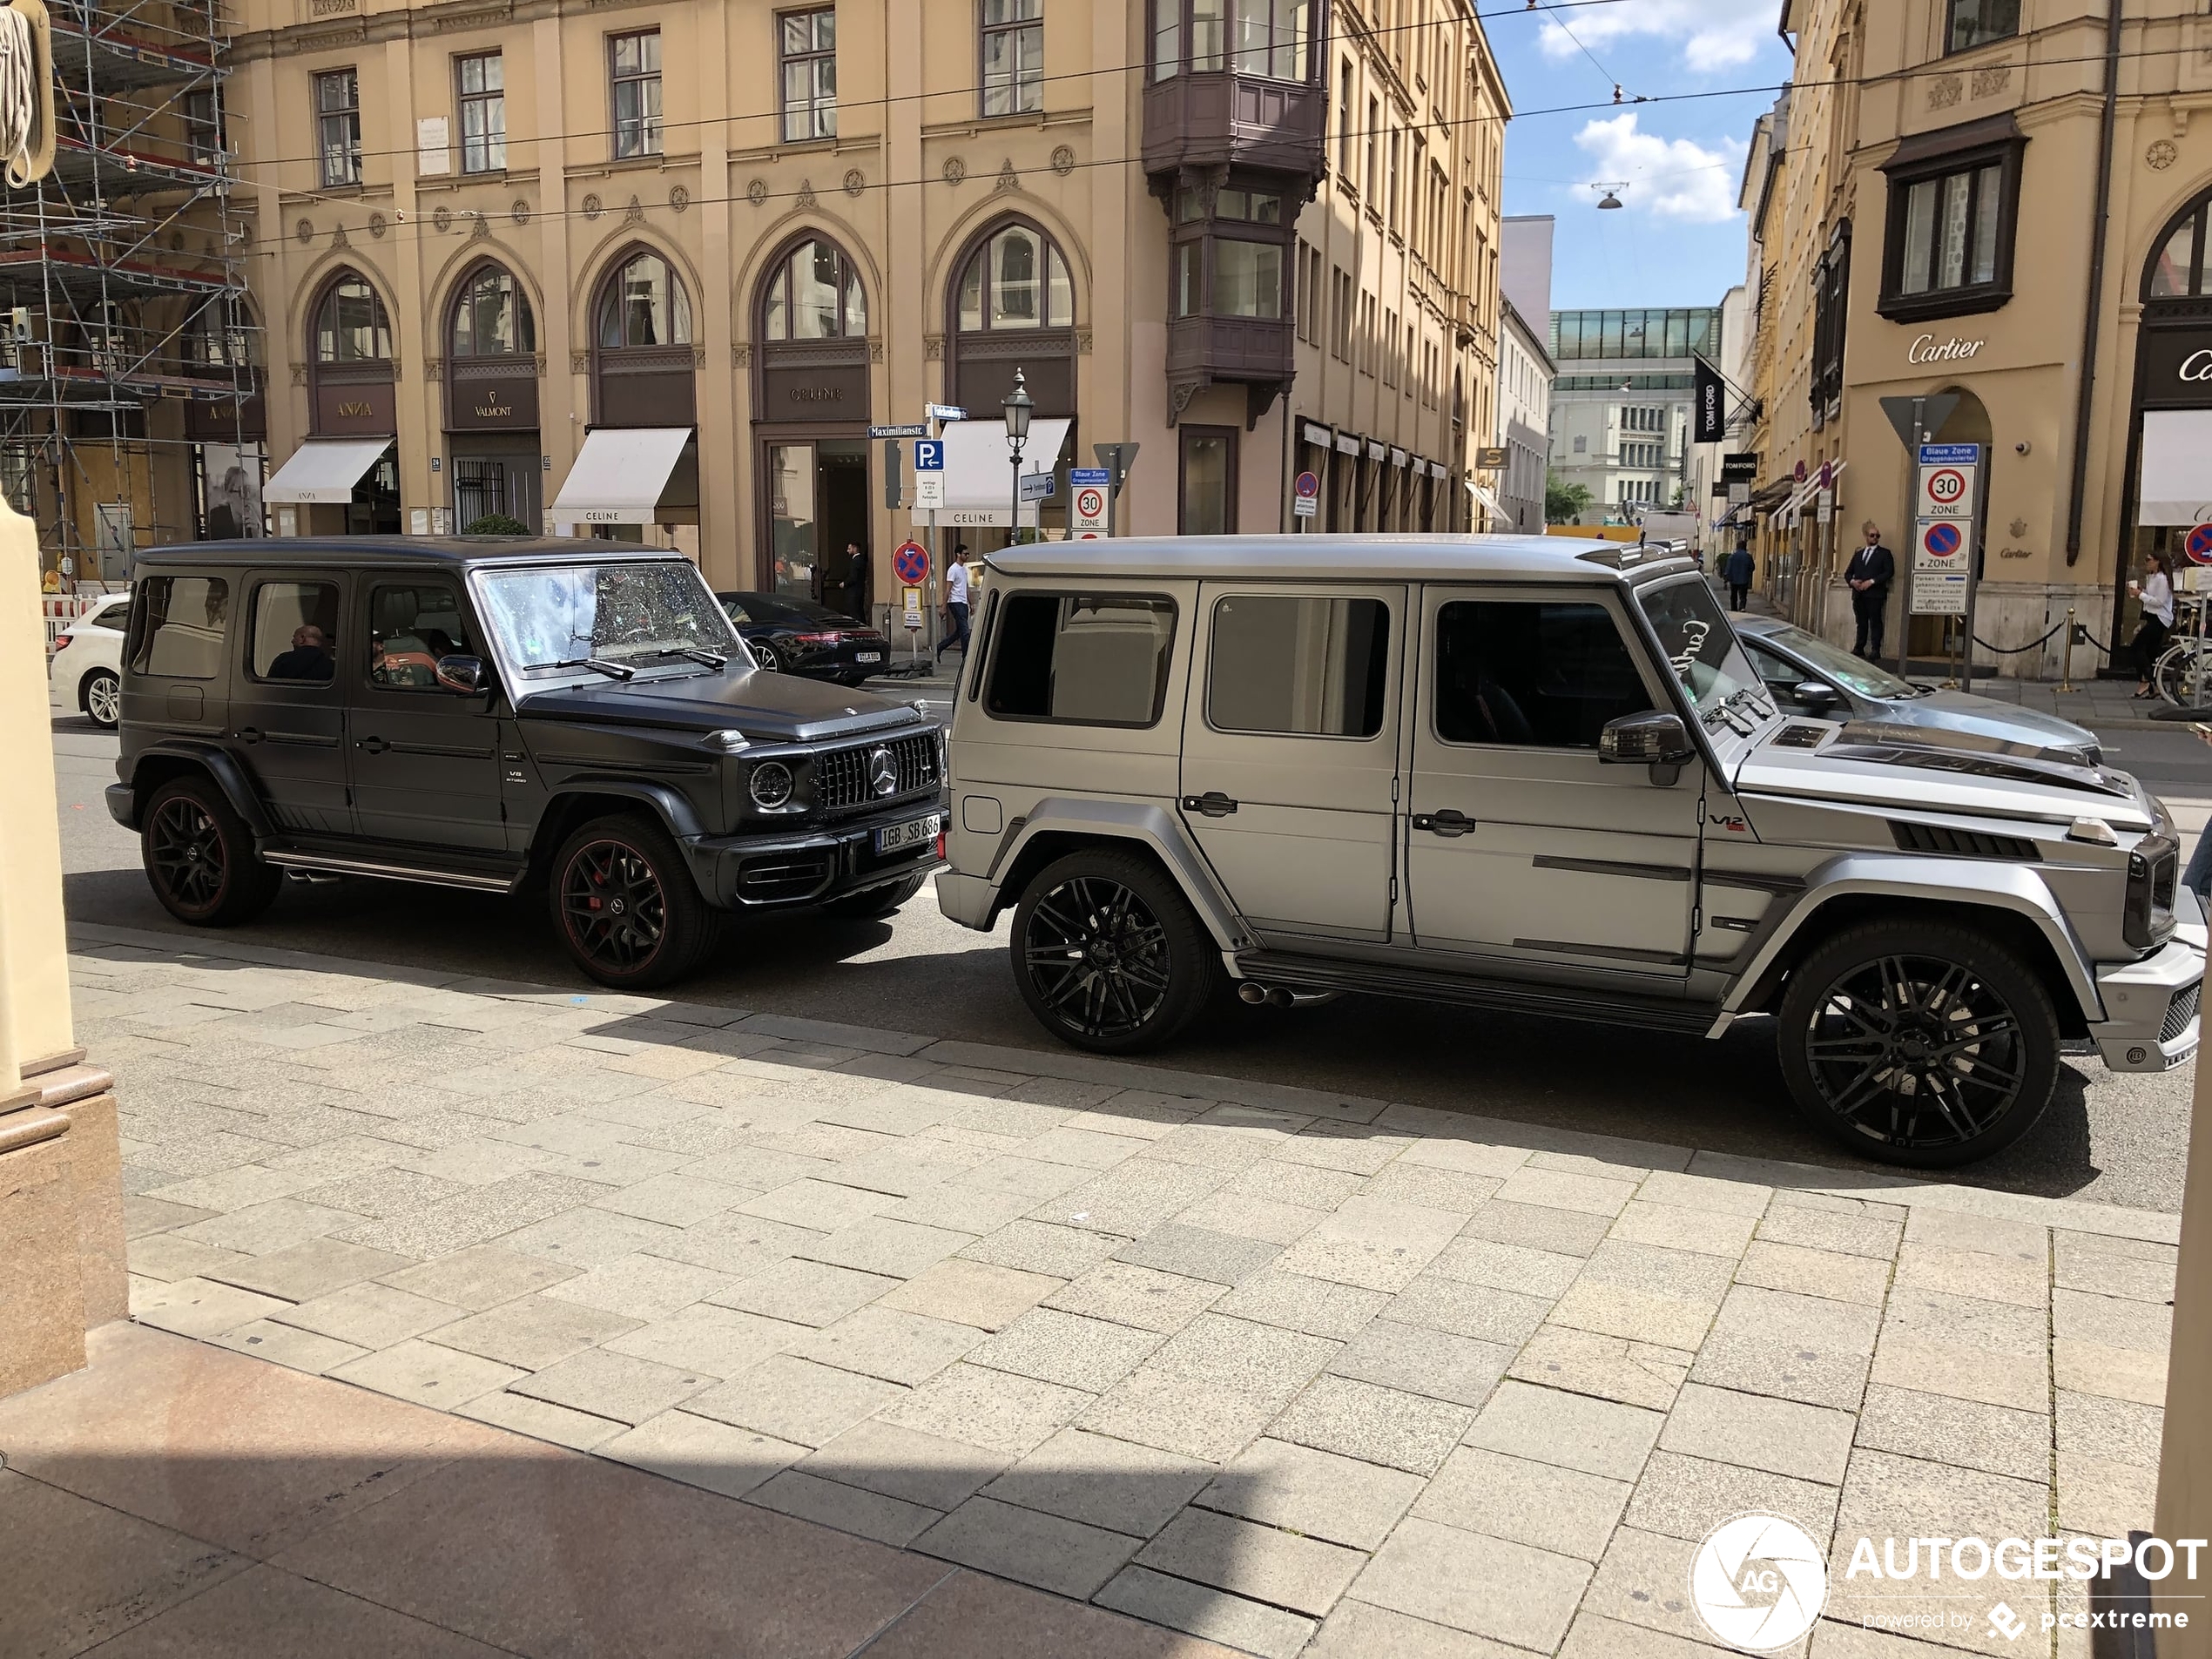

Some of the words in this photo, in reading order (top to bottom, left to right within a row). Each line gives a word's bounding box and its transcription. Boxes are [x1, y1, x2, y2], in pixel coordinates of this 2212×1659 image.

[1908, 334, 1985, 364] Cartier
[791, 388, 843, 401] CELINE
[1706, 384, 1715, 408] FORD
[475, 406, 512, 417] VALMONT
[1706, 408, 1715, 432] TOM
[871, 426, 923, 436] Maximilianstr.
[920, 444, 935, 467] P
[1484, 448, 1503, 465] S
[1926, 447, 1949, 455] Blaue
[1935, 478, 1958, 494] 30
[1082, 496, 1097, 510] 30
[585, 511, 618, 521] CELINE
[1930, 505, 1959, 515] ZONE
[954, 513, 994, 523] CELINE
[2000, 548, 2033, 559] Cartier
[1927, 558, 1956, 568] ZONE
[1709, 814, 1743, 826] V12
[882, 826, 900, 848] IGB
[908, 821, 921, 841] SB
[921, 817, 939, 837] 686
